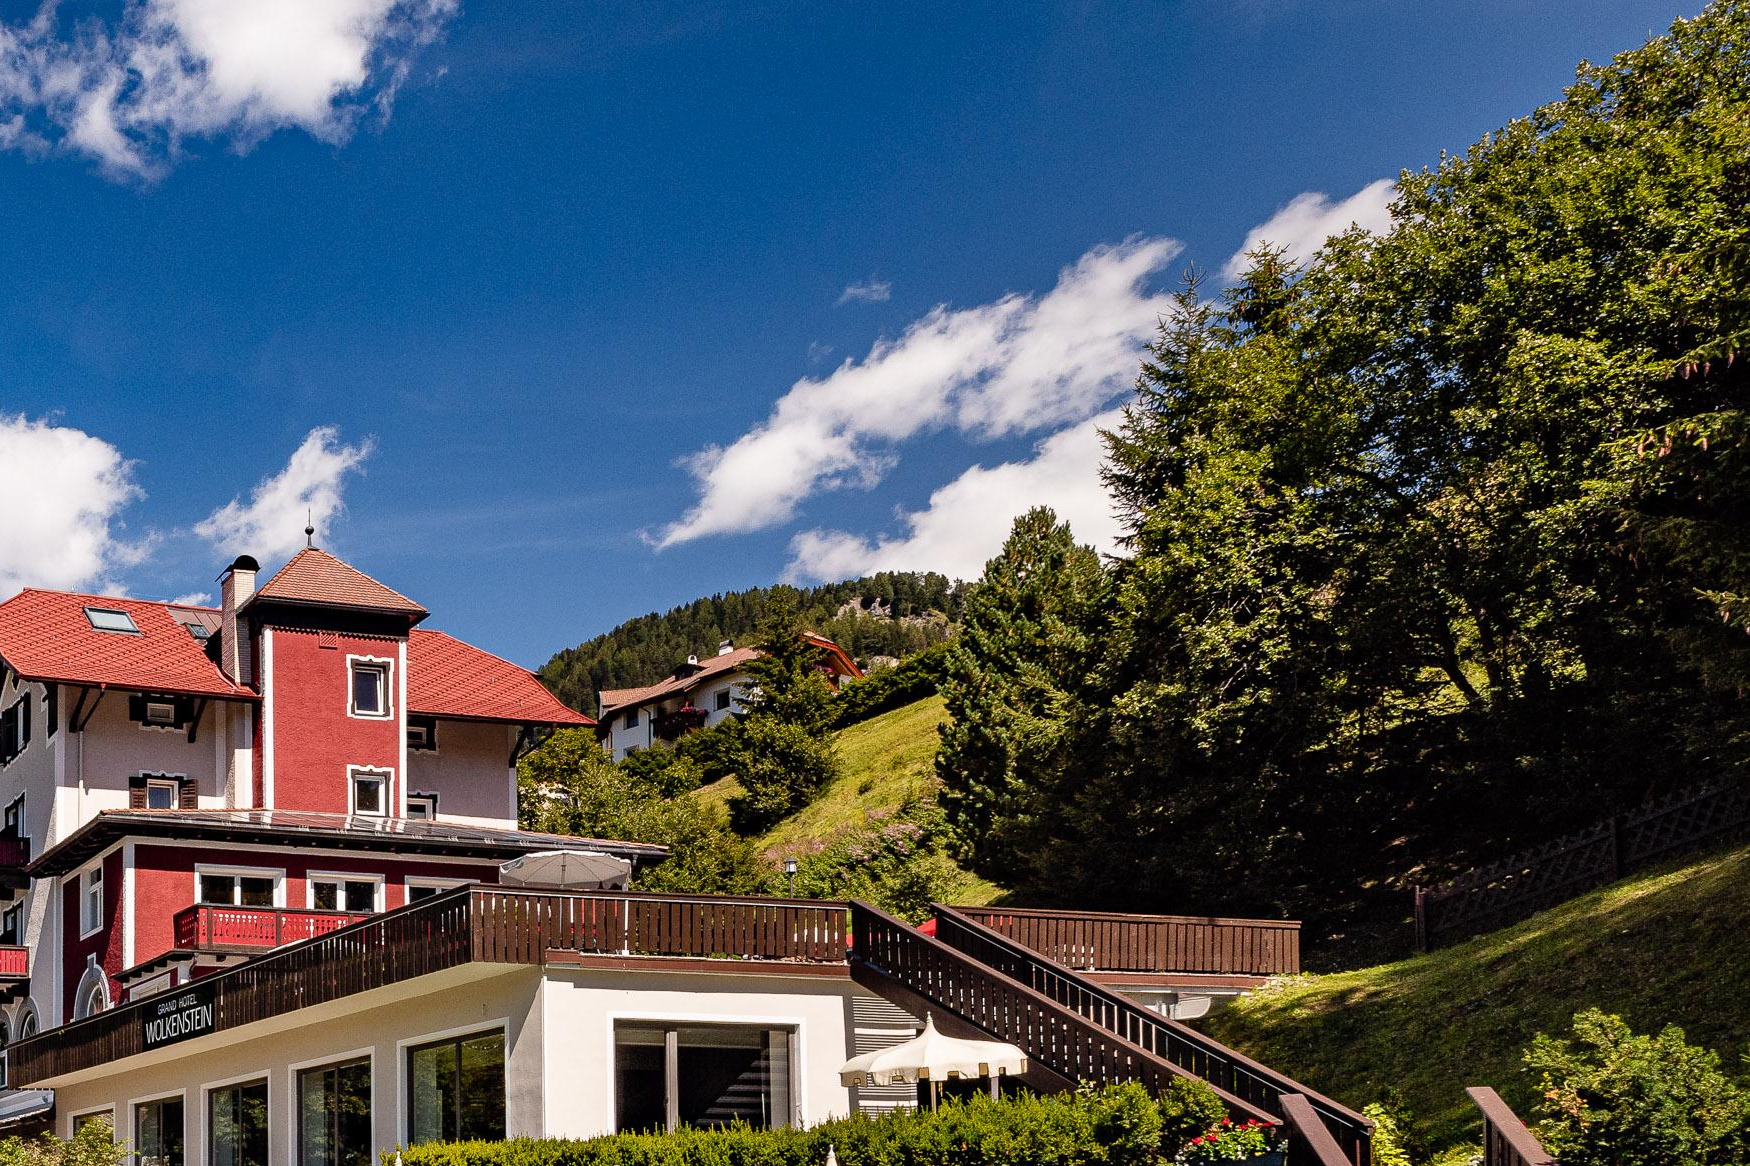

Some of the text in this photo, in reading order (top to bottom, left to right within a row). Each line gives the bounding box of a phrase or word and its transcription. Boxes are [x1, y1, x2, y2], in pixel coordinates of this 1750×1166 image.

[157, 993, 198, 1015] GRAND HOTEL
[145, 1003, 212, 1044] WOLKENSTEIN
